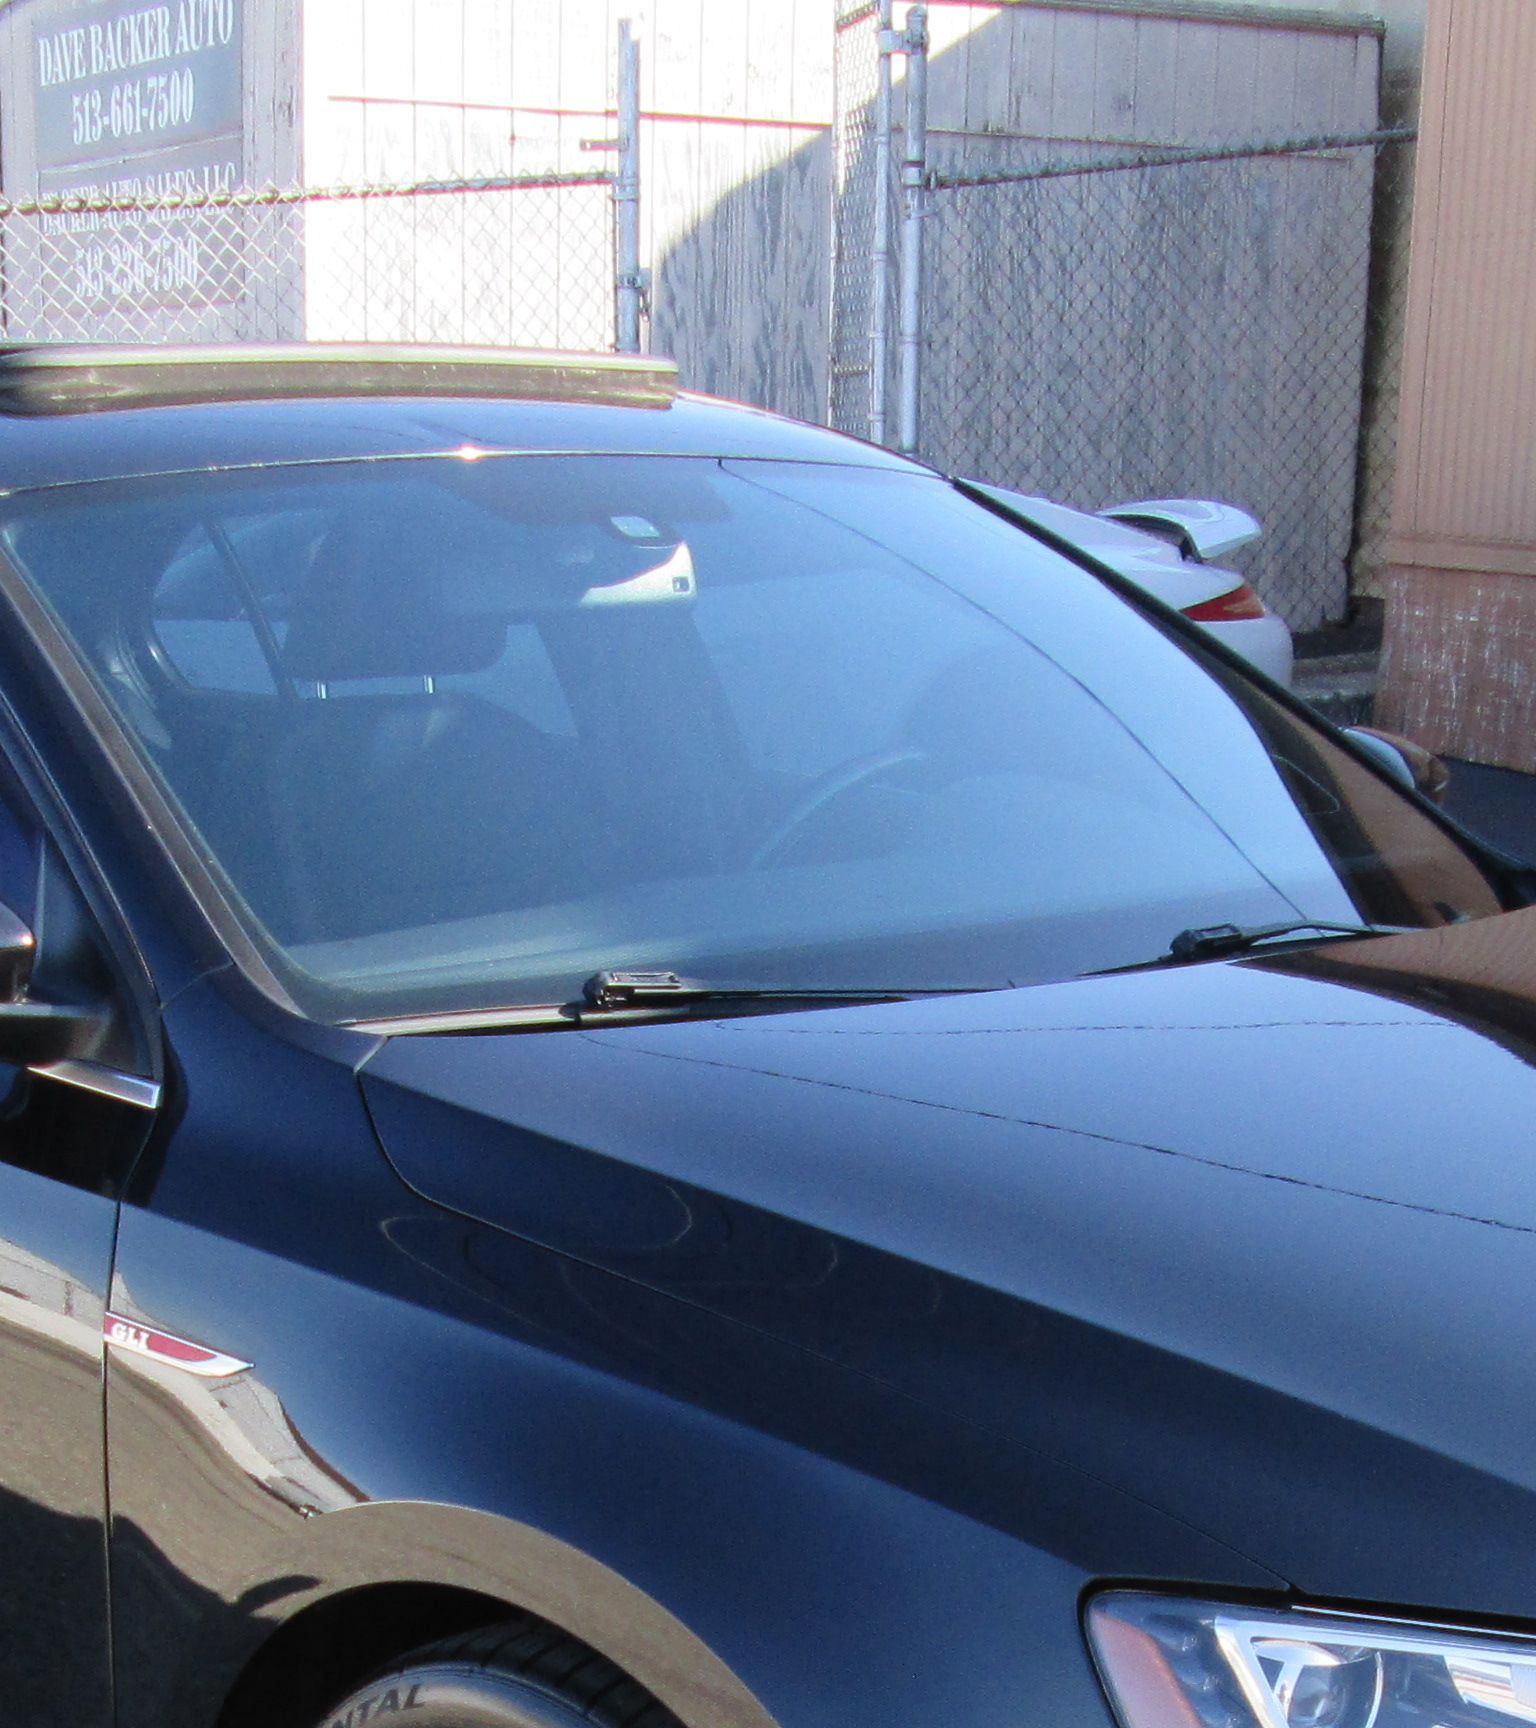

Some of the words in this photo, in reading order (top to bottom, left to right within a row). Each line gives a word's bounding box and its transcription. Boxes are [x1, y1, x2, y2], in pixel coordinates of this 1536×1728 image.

[38, 28, 87, 87] DAVE
[89, 6, 171, 76] BACKER
[175, 0, 234, 55] AUTO
[72, 66, 195, 146] 513-661-7500
[111, 1321, 150, 1351] GLI
